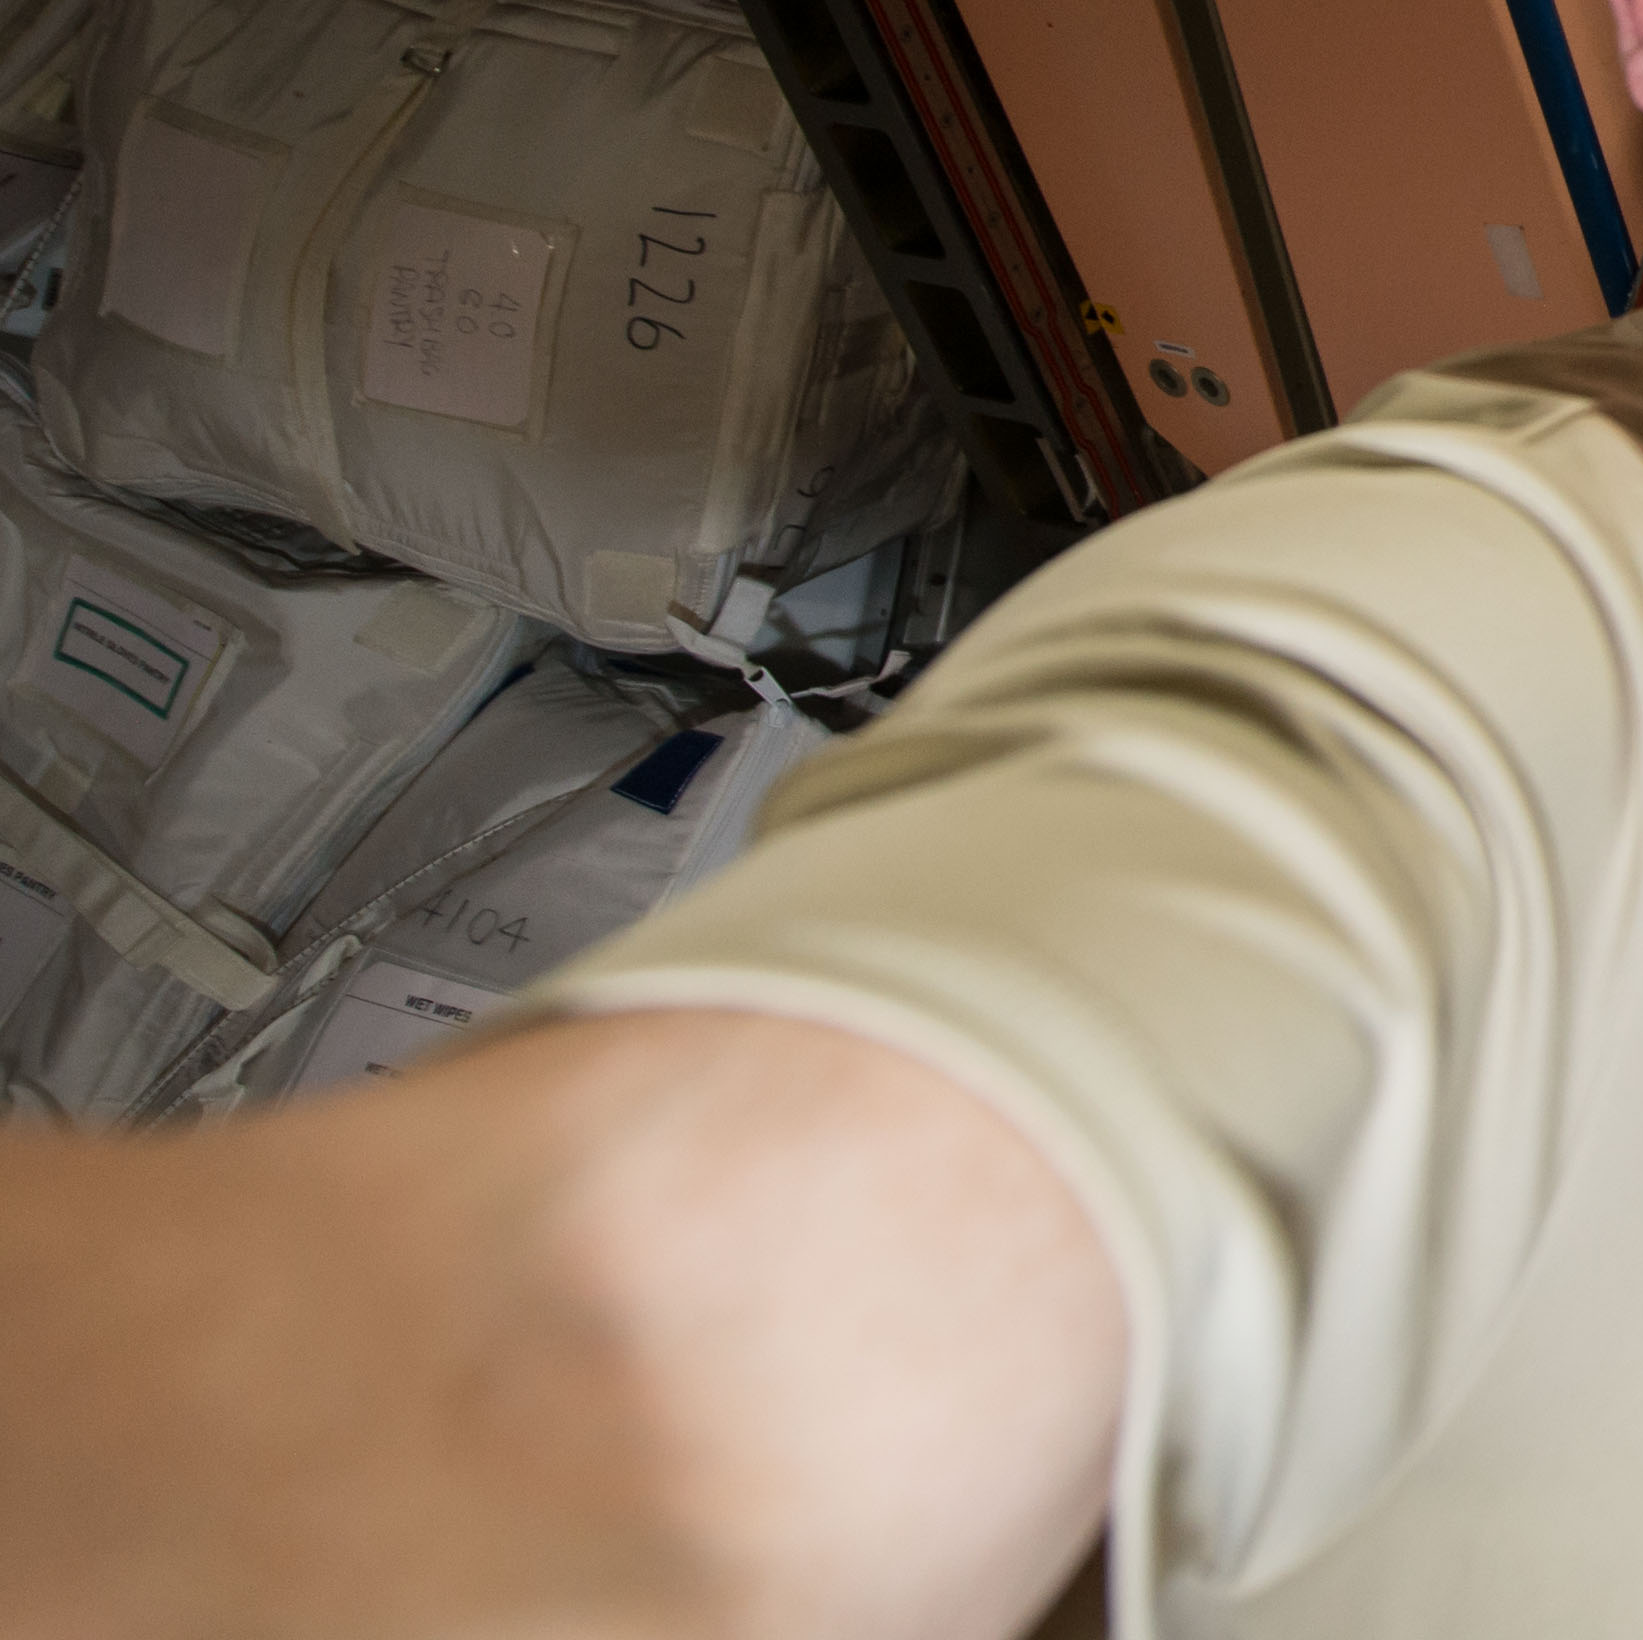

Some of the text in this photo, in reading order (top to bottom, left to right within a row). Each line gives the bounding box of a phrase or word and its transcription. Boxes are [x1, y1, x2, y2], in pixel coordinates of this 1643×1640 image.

[626, 204, 718, 354] 1226
[419, 887, 532, 954] 4104
[404, 994, 474, 1024] WET WIPES
